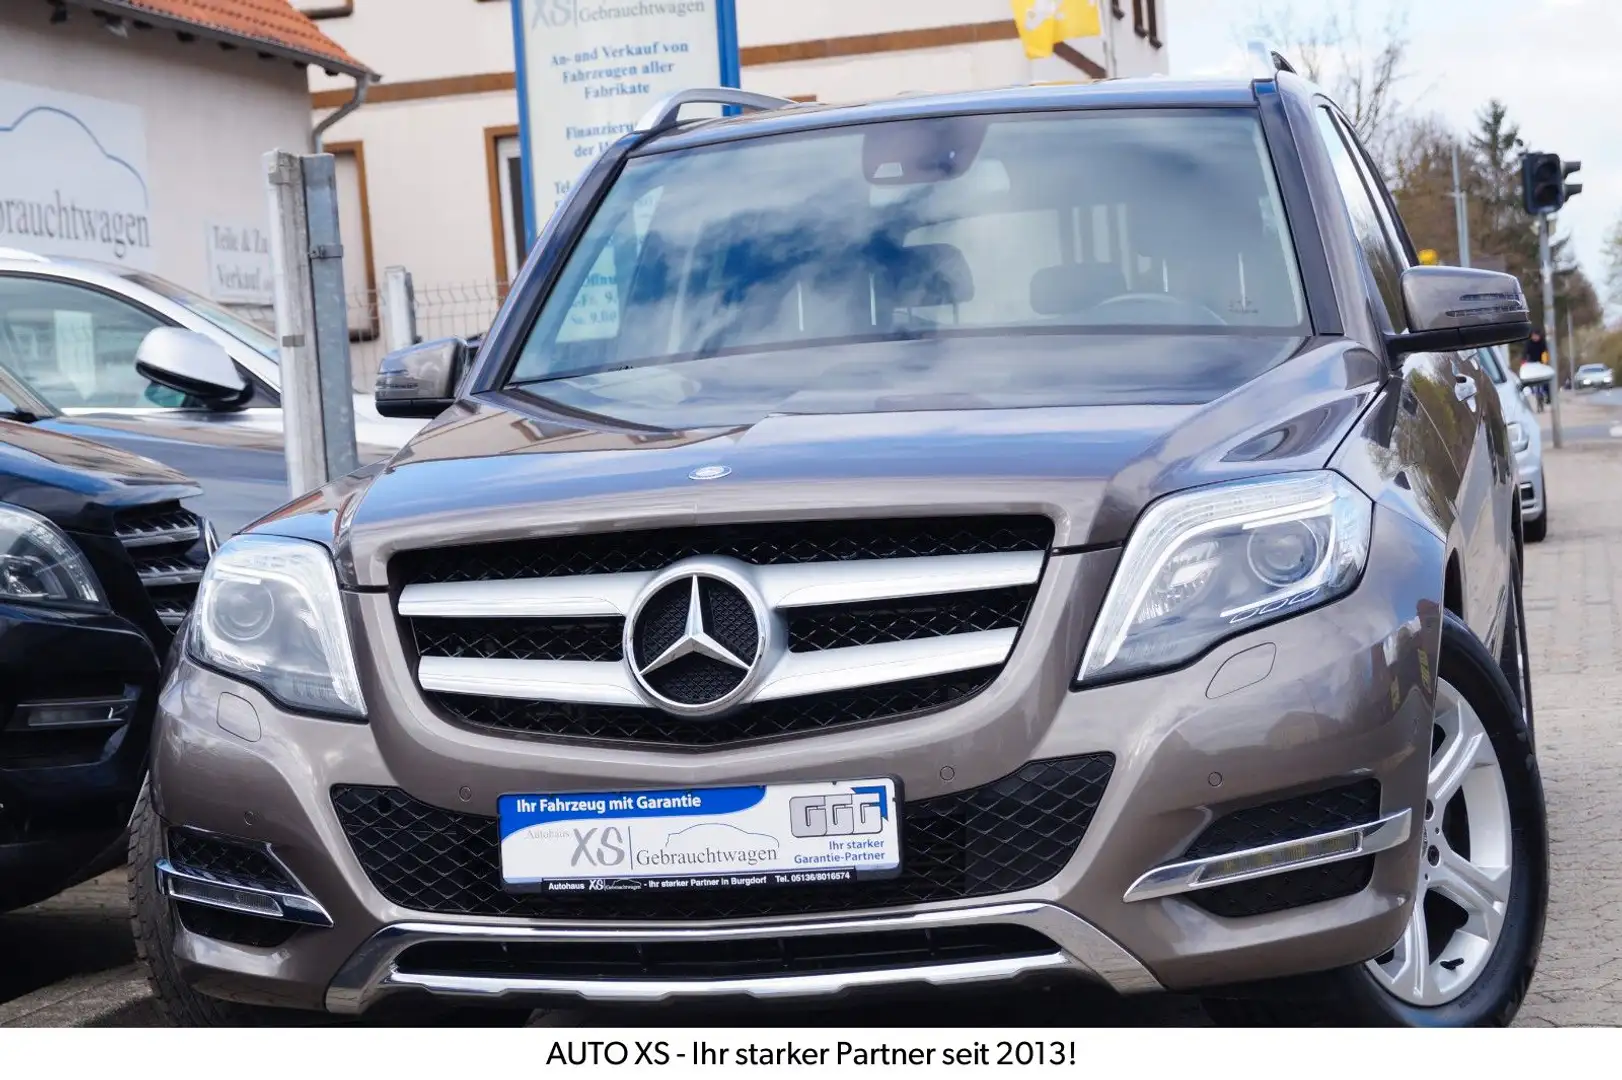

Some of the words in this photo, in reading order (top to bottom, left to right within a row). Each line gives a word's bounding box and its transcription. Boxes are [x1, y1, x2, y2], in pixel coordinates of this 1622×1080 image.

[579, 0, 706, 24] Gebrauchtwagen
[551, 54, 571, 67] An-
[575, 49, 599, 63] und
[602, 42, 659, 59] Verkauf
[663, 42, 689, 54] von
[563, 66, 637, 84] Fahrzeugen
[642, 61, 676, 75] aller
[584, 82, 651, 100] Fabrikate
[516, 799, 537, 813] Ihr
[540, 797, 606, 814] Fahrzeug
[609, 796, 634, 810] mit
[636, 793, 702, 810] Garantie
[525, 829, 571, 840] Autohaus
[570, 826, 625, 867] XS
[636, 847, 778, 866] Gebrauchtwagen
[829, 840, 844, 851] Ihr
[846, 839, 885, 850] starker
[794, 851, 886, 864] Garantie-Partner
[548, 882, 585, 891] Autohaus
[648, 880, 660, 889] Ihr
[661, 879, 689, 888] starker
[690, 877, 720, 887] Partner
[721, 876, 730, 886] in
[731, 876, 767, 887] Burgdorf
[775, 874, 790, 884] Tel.
[790, 871, 851, 883] 05136/8016574
